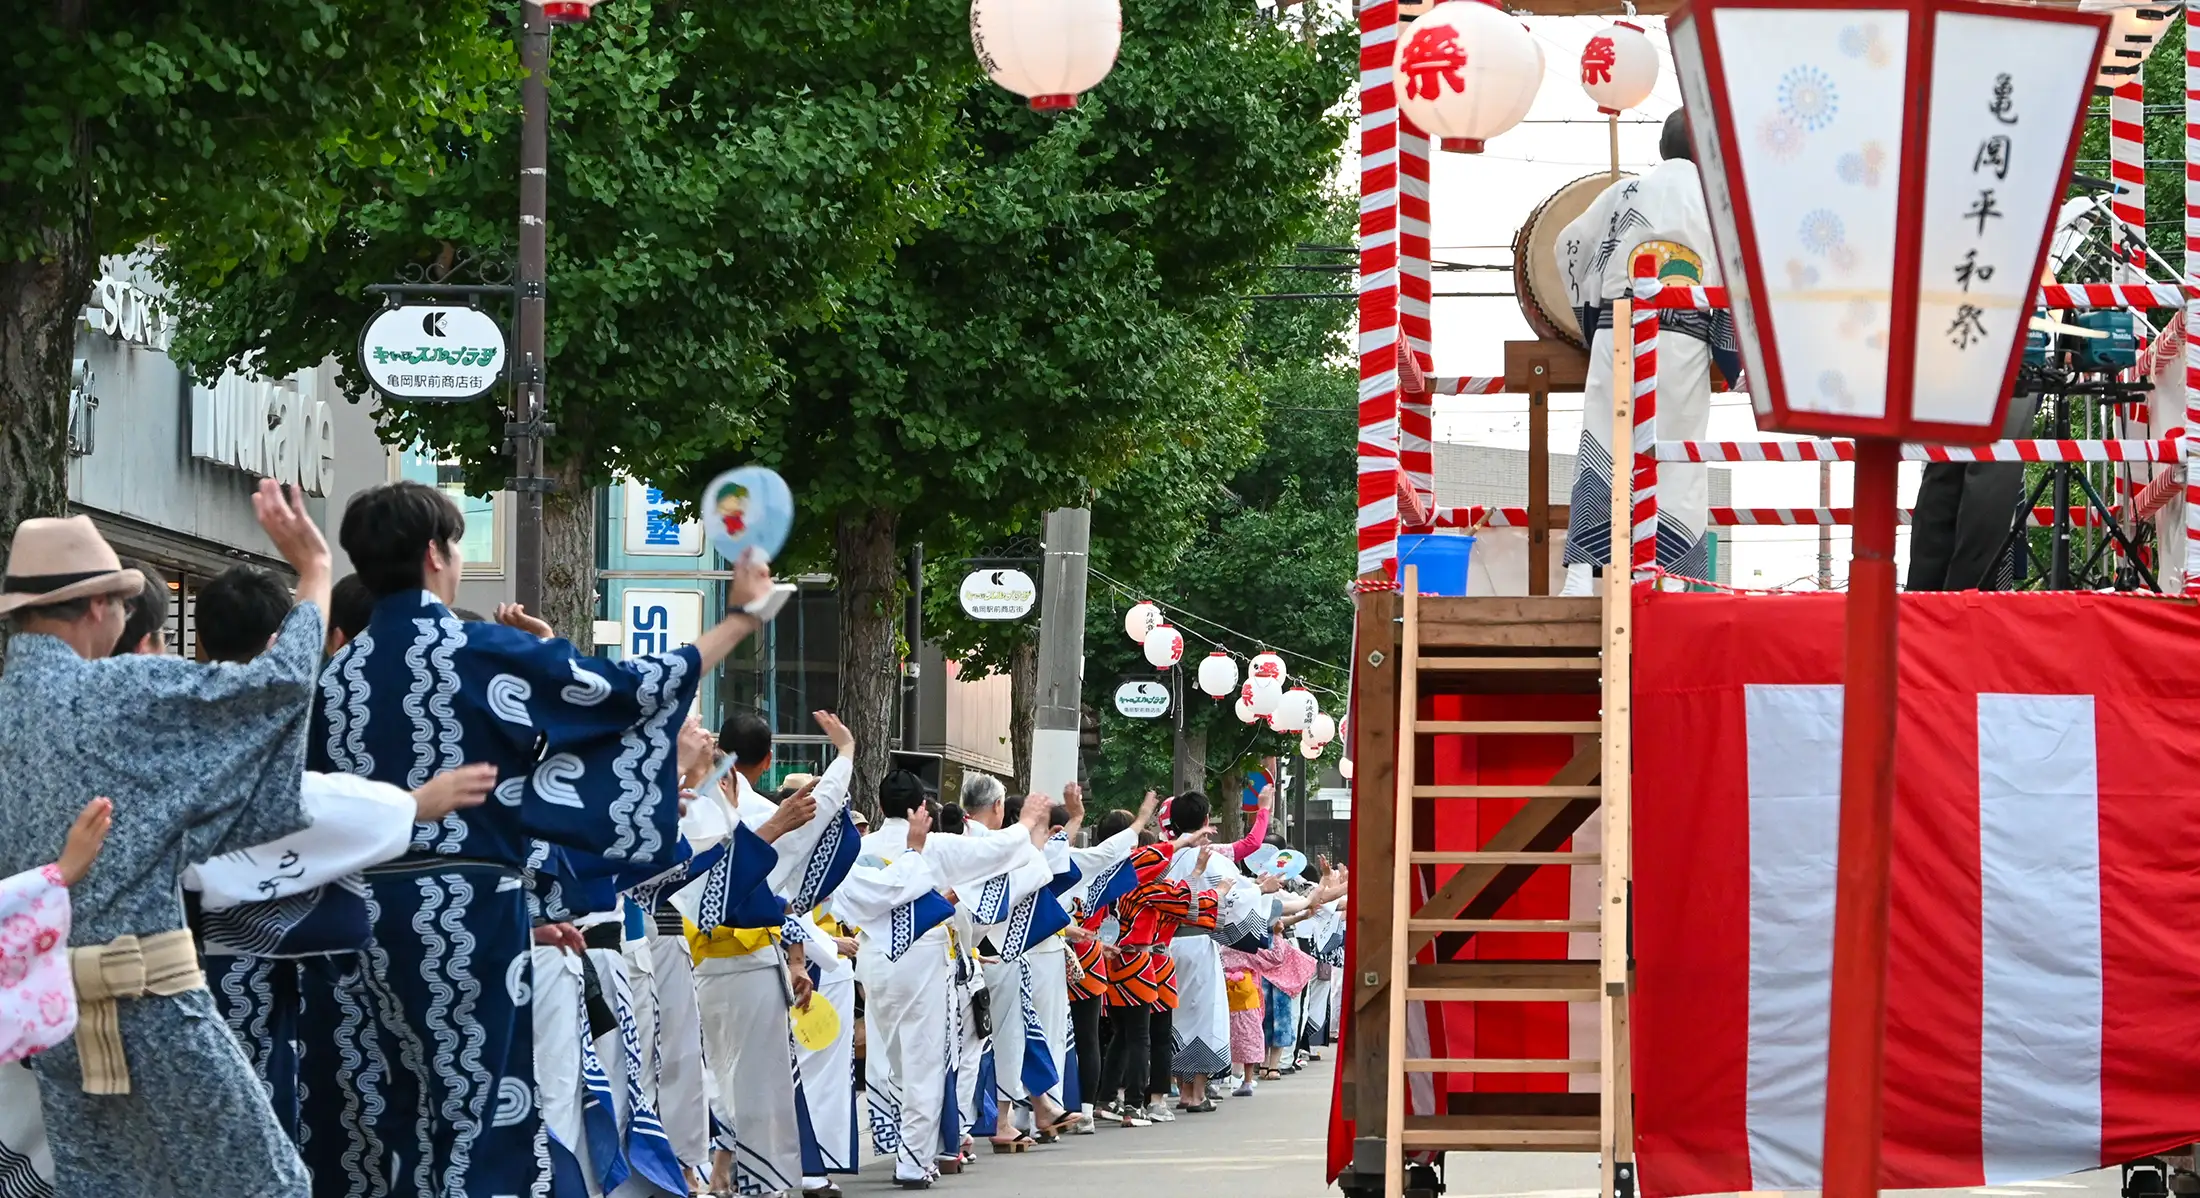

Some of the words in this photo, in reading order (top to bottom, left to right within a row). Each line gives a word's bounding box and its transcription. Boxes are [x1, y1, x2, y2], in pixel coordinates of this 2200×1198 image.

[1400, 23, 1468, 101] 祭
[1581, 36, 1615, 85] 祭
[387, 374, 482, 389] 亀岡駅前商店街
